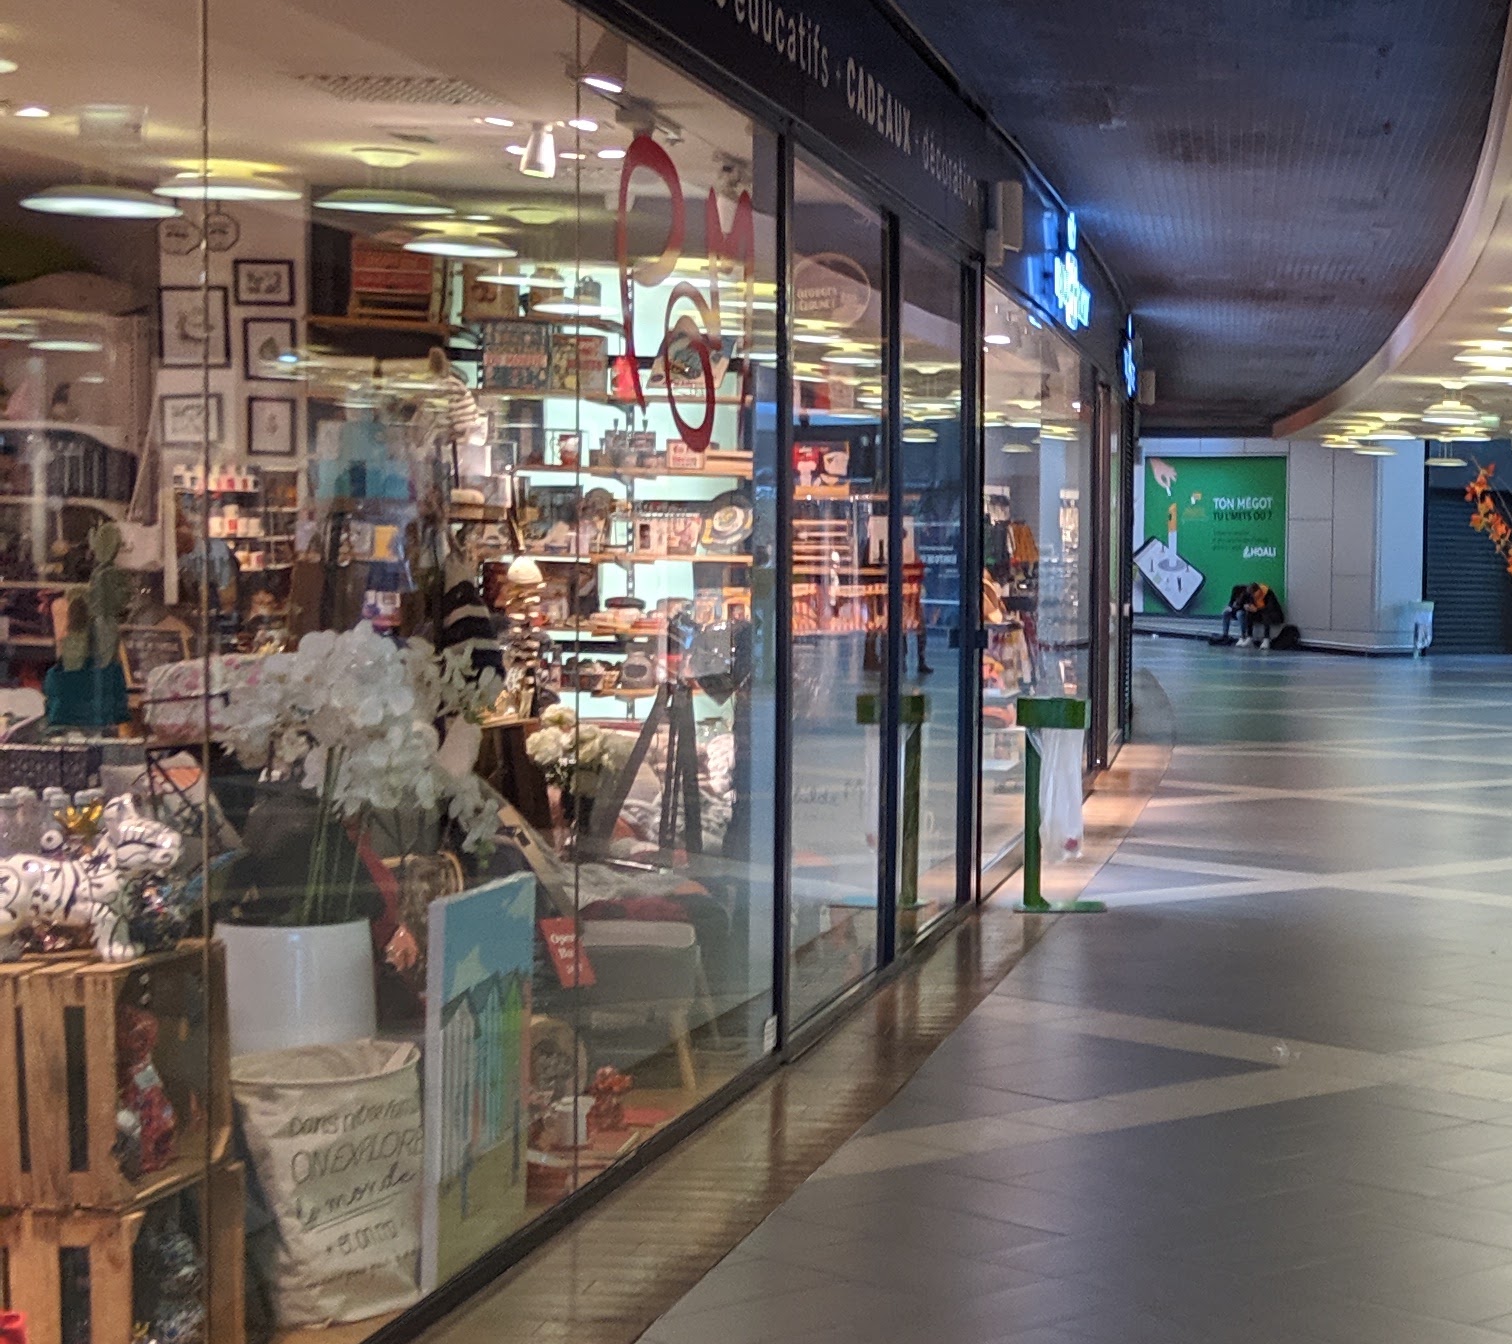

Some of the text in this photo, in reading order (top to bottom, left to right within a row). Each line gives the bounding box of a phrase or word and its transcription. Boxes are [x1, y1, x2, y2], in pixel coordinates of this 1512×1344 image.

[847, 57, 912, 155] CADEAUX
[1212, 497, 1235, 511] TON
[1213, 511, 1224, 522] TU
